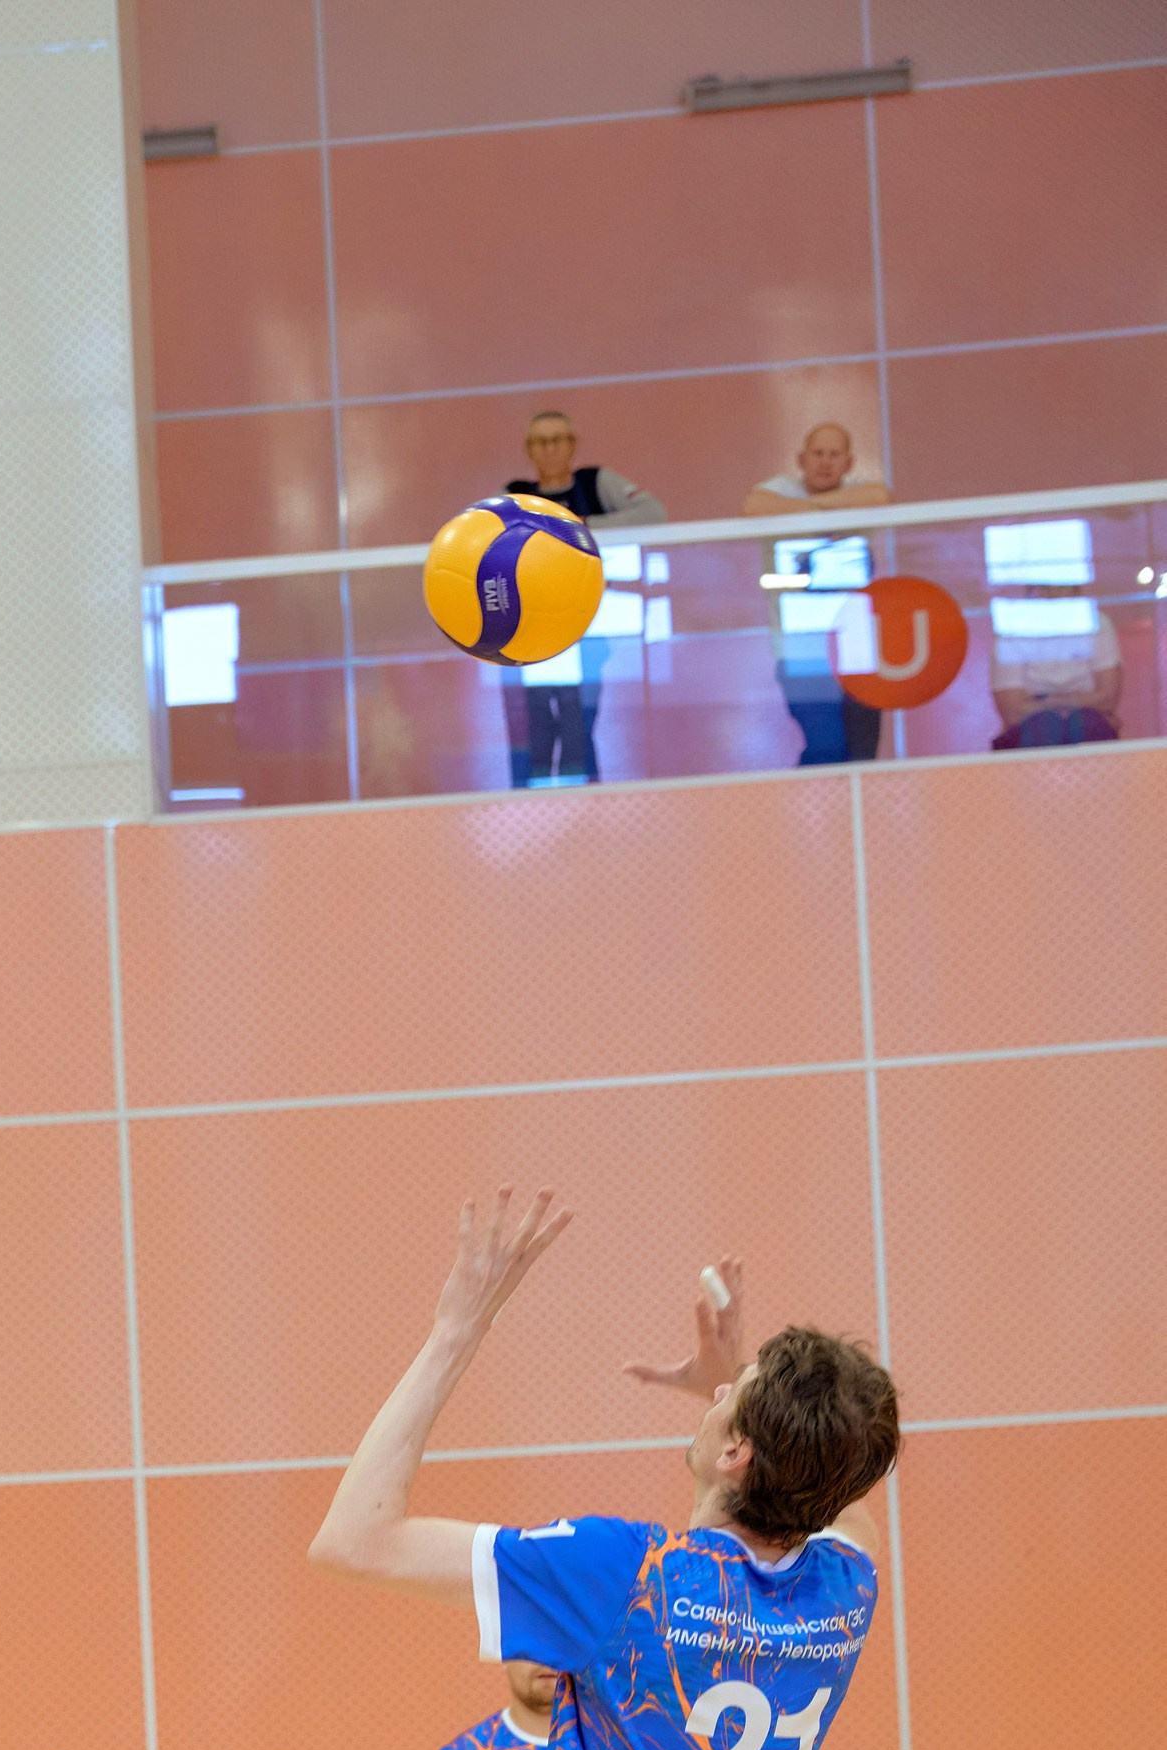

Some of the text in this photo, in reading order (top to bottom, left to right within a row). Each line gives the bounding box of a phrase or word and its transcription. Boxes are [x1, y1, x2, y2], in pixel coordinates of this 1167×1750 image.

[845, 1606, 867, 1628] ГЭС
[666, 1626, 738, 1653] имени
[739, 1635, 774, 1658] П.С.
